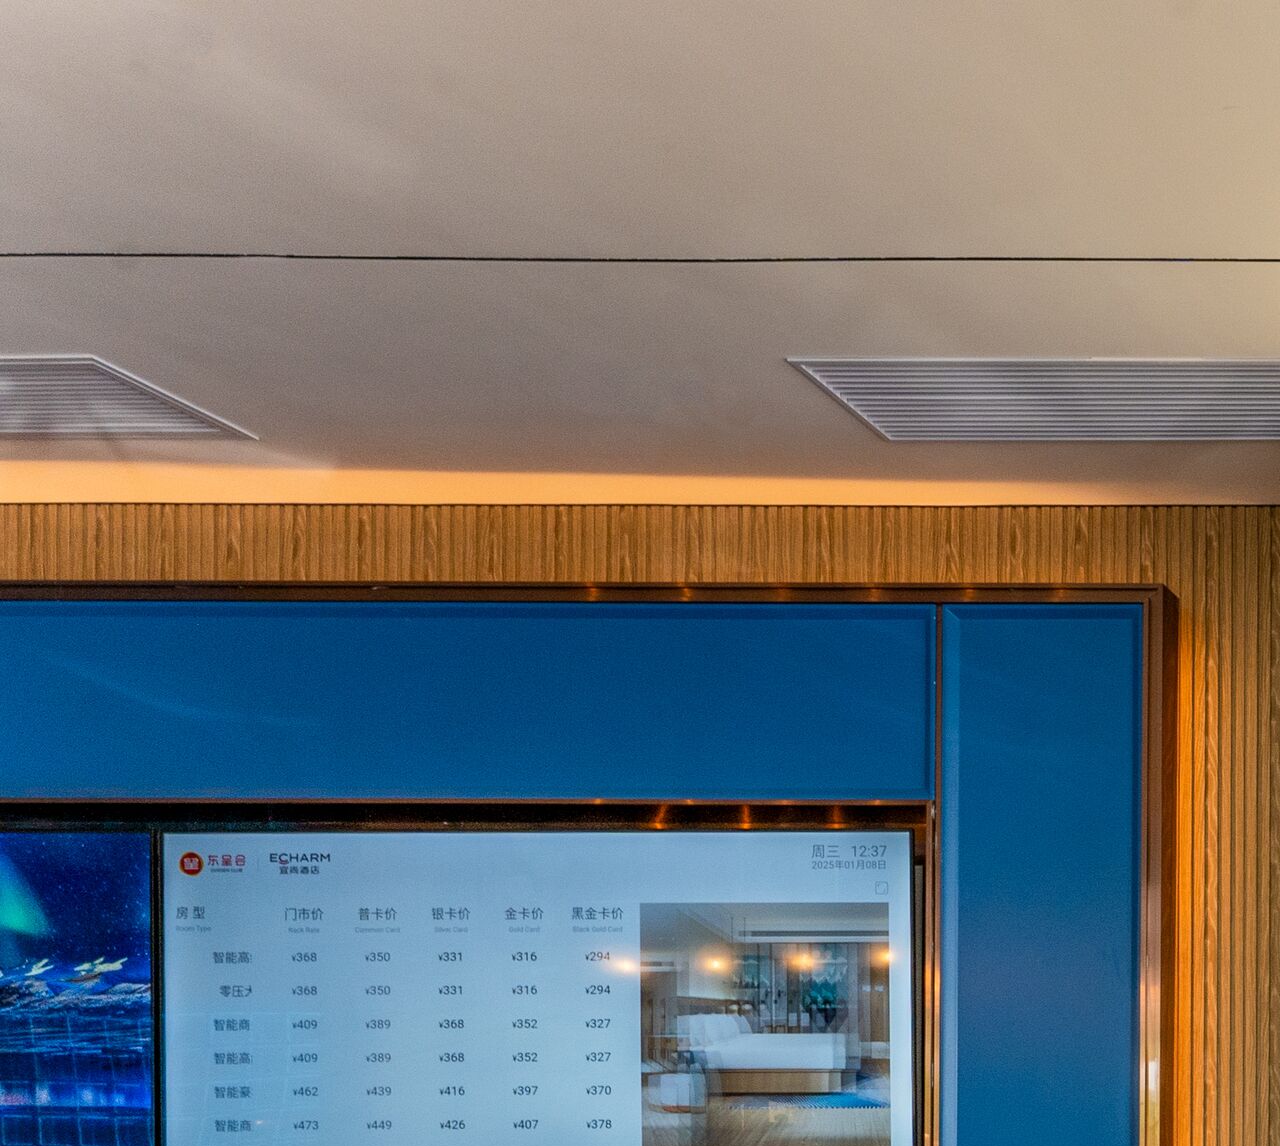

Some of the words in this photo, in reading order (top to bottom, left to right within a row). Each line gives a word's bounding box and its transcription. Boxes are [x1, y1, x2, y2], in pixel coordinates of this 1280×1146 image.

[812, 844, 840, 858] 周三
[852, 845, 887, 857] 12:37
[270, 853, 331, 865] ECHARM
[812, 860, 886, 870] 2025年01月08日
[284, 907, 324, 921] 门市价
[359, 907, 398, 921] 普卡价
[432, 907, 470, 921] 银卡价
[505, 907, 544, 920] 金卡价
[572, 906, 624, 920] 黑金卡价
[213, 952, 253, 964] 智能高
[292, 952, 318, 962] ¥368
[365, 952, 391, 962] ¥350
[438, 952, 463, 962] ¥331
[512, 952, 537, 961] ¥316
[585, 952, 611, 961] ¥294
[292, 986, 318, 996] ¥368
[365, 985, 391, 995] ¥350
[439, 985, 463, 995] ¥331
[512, 985, 538, 995] ¥316
[585, 985, 611, 995] ¥294
[292, 1019, 318, 1029] ¥409
[365, 1019, 391, 1029] ¥389
[439, 1019, 465, 1029] ¥368
[512, 1019, 538, 1029] ¥352
[585, 1019, 611, 1028] ¥327
[214, 1052, 254, 1065] 智能高
[293, 1053, 318, 1062] ¥409
[366, 1053, 391, 1062] ¥389
[439, 1052, 465, 1062] ¥368
[512, 1052, 538, 1062] ¥352
[586, 1052, 611, 1062] ¥327
[293, 1087, 319, 1096] ¥462
[366, 1086, 392, 1096] ¥439
[440, 1086, 465, 1095] ¥416
[513, 1086, 538, 1095] ¥397
[586, 1085, 612, 1095] ¥370
[294, 1121, 319, 1130] ¥473
[367, 1120, 392, 1130] ¥449
[440, 1120, 465, 1129] ¥426
[513, 1119, 538, 1129] ¥407
[586, 1119, 612, 1129] ¥378
